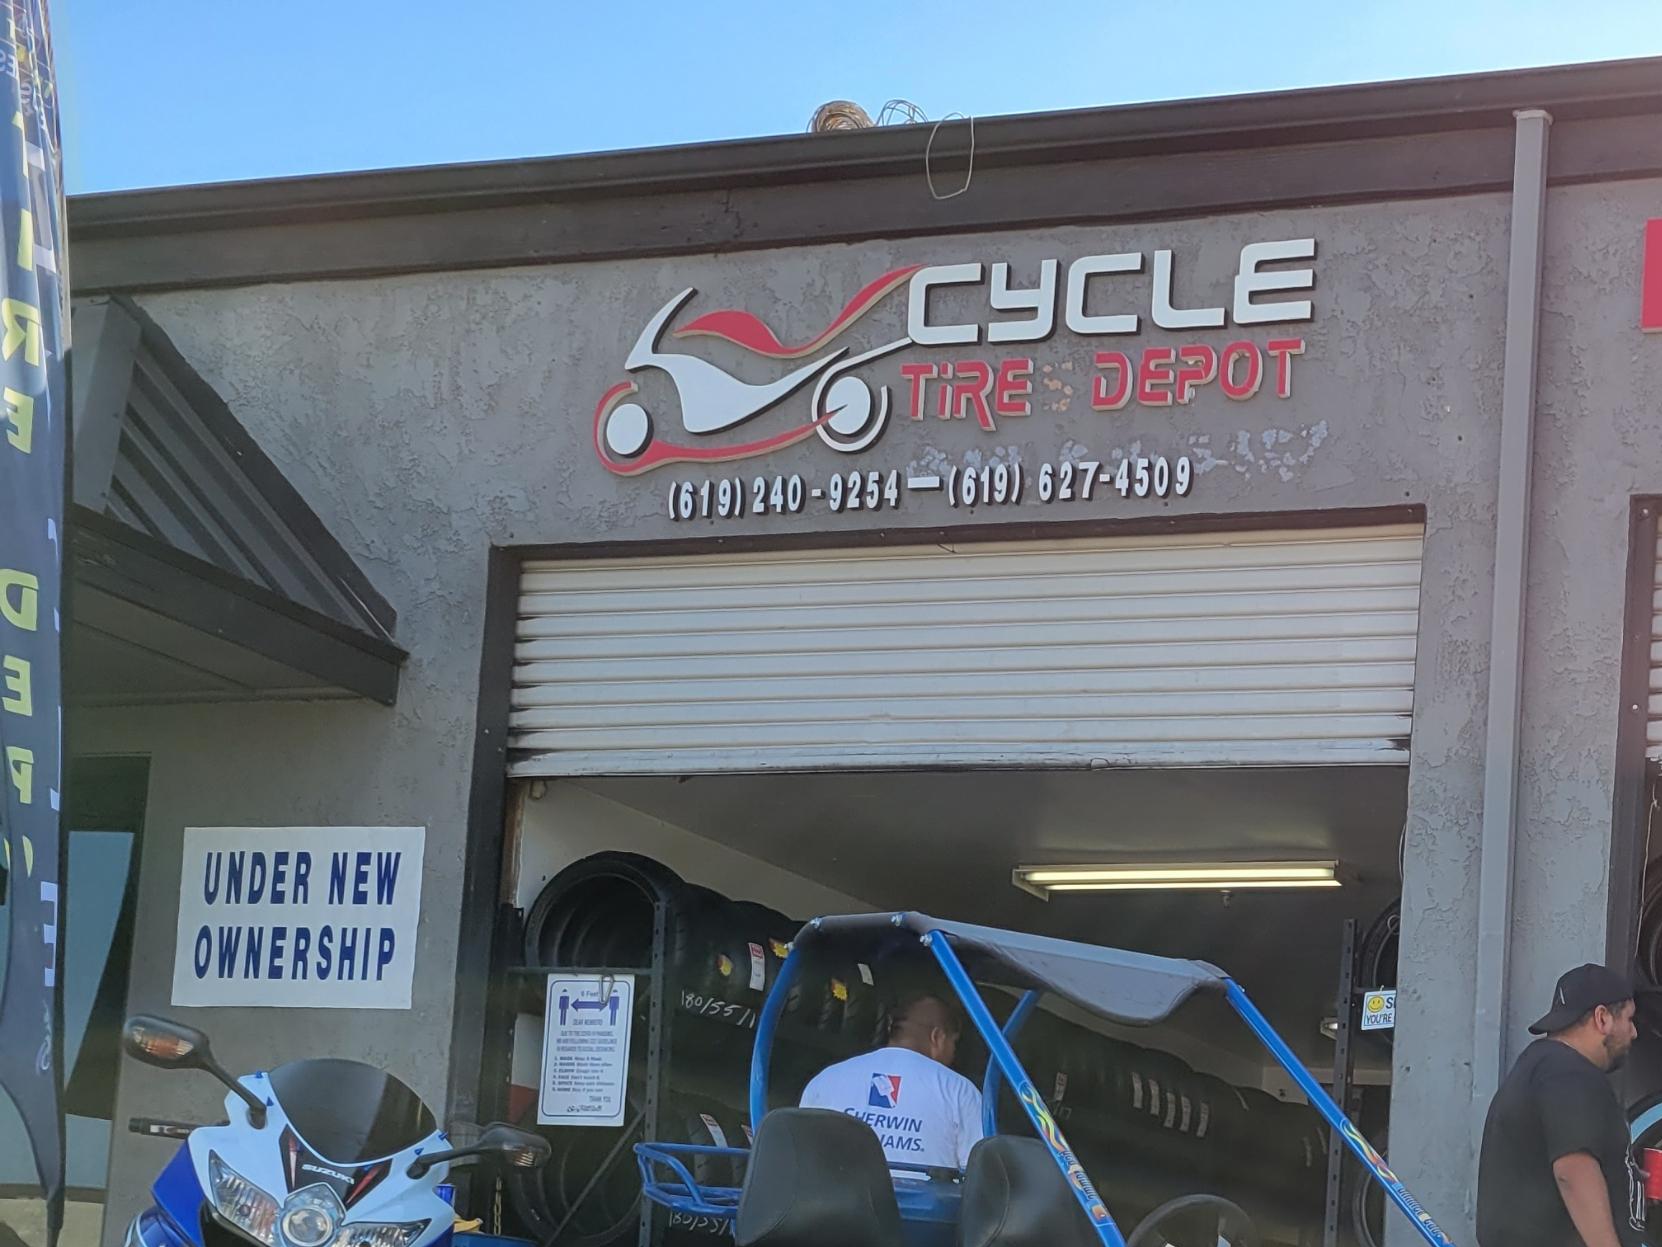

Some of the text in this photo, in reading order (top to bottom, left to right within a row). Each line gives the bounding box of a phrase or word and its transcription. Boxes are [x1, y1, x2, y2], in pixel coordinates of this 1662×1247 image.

[907, 238, 1317, 344] CYCLE
[899, 338, 1307, 431] TIRE DEPOT
[204, 851, 401, 905] UNDER NEW
[194, 925, 395, 981] OWNERSHIP
[302, 1164, 355, 1185] SUZUKI
